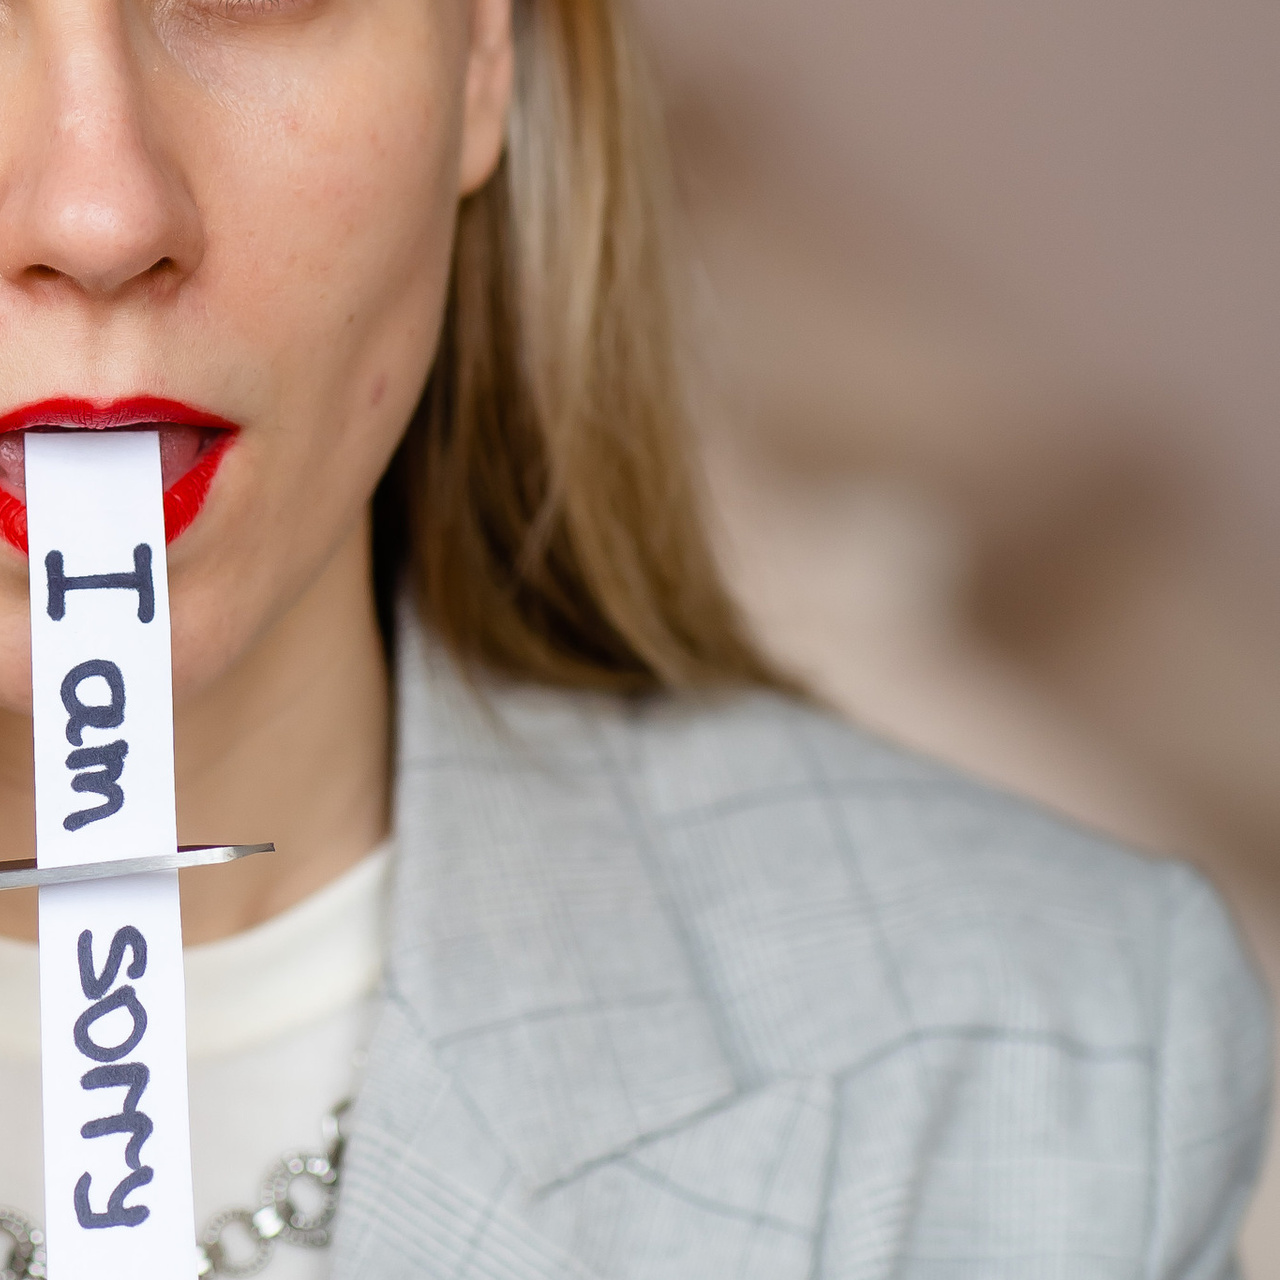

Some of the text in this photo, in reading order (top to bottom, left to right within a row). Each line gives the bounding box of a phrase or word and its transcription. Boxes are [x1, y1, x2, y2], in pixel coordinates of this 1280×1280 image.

[44, 542, 155, 1229] I am sorry
